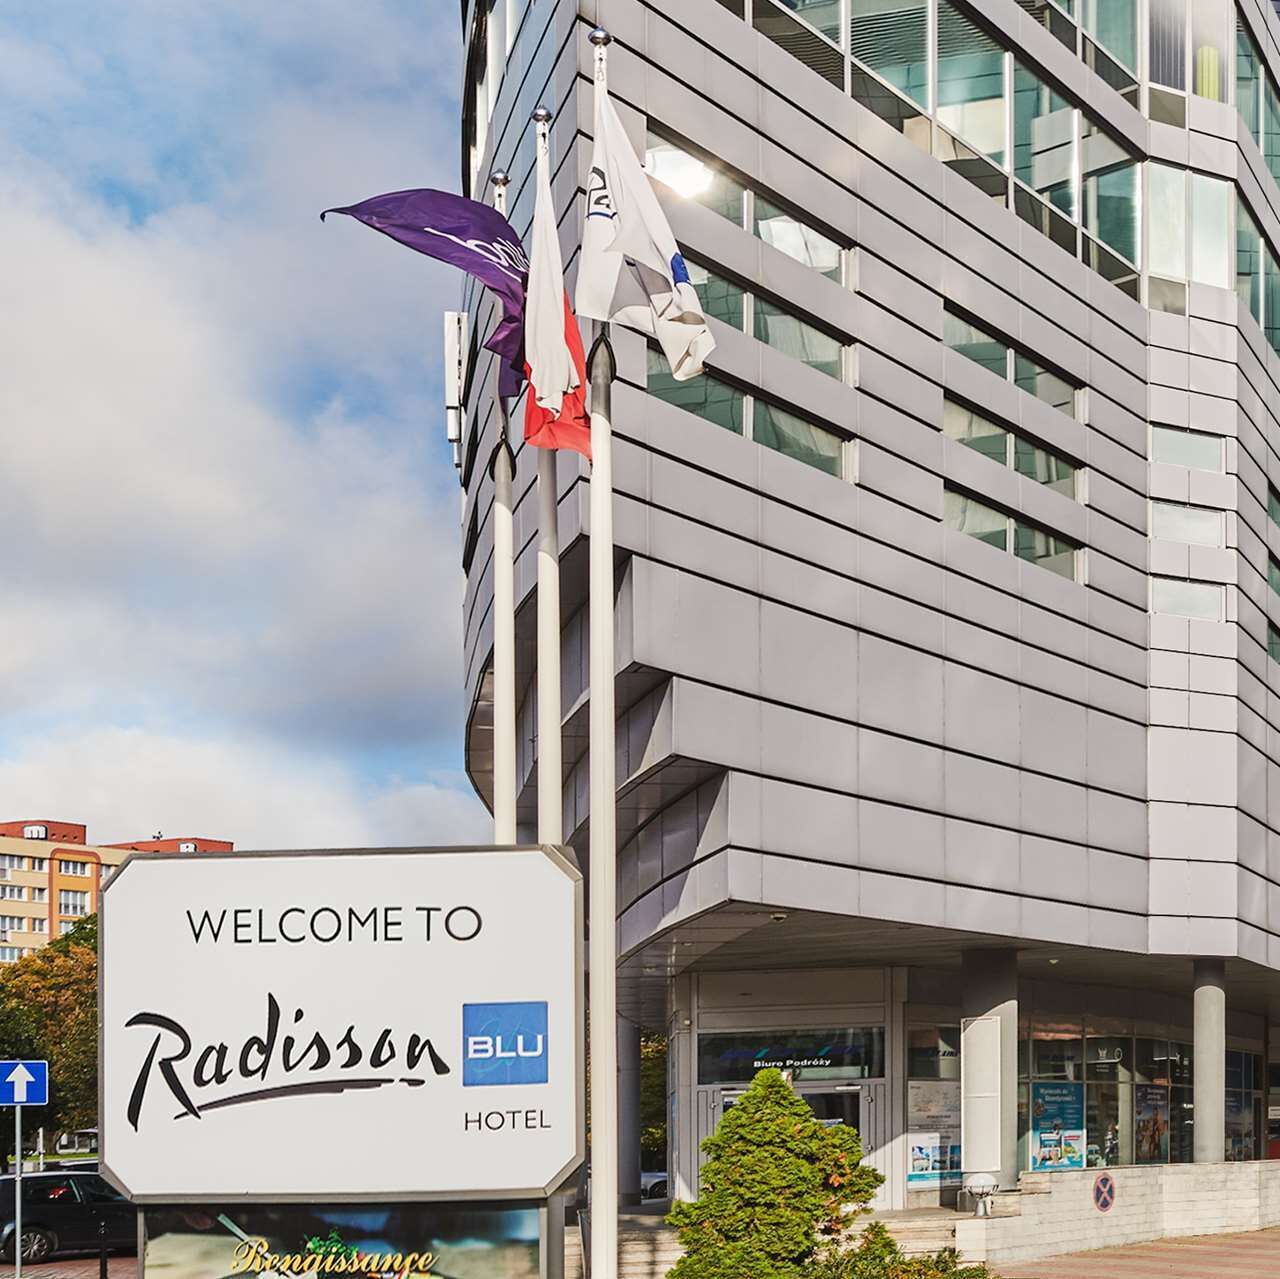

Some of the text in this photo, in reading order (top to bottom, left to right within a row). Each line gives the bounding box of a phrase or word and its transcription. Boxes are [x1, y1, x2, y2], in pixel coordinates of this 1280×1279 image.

[185, 905, 483, 945] WELCOME TO
[124, 991, 545, 1133] Radisson BLU
[753, 1058, 832, 1068] Biuro Podróży
[463, 1109, 552, 1132] HOTEL
[231, 1236, 441, 1276] Renaissance
